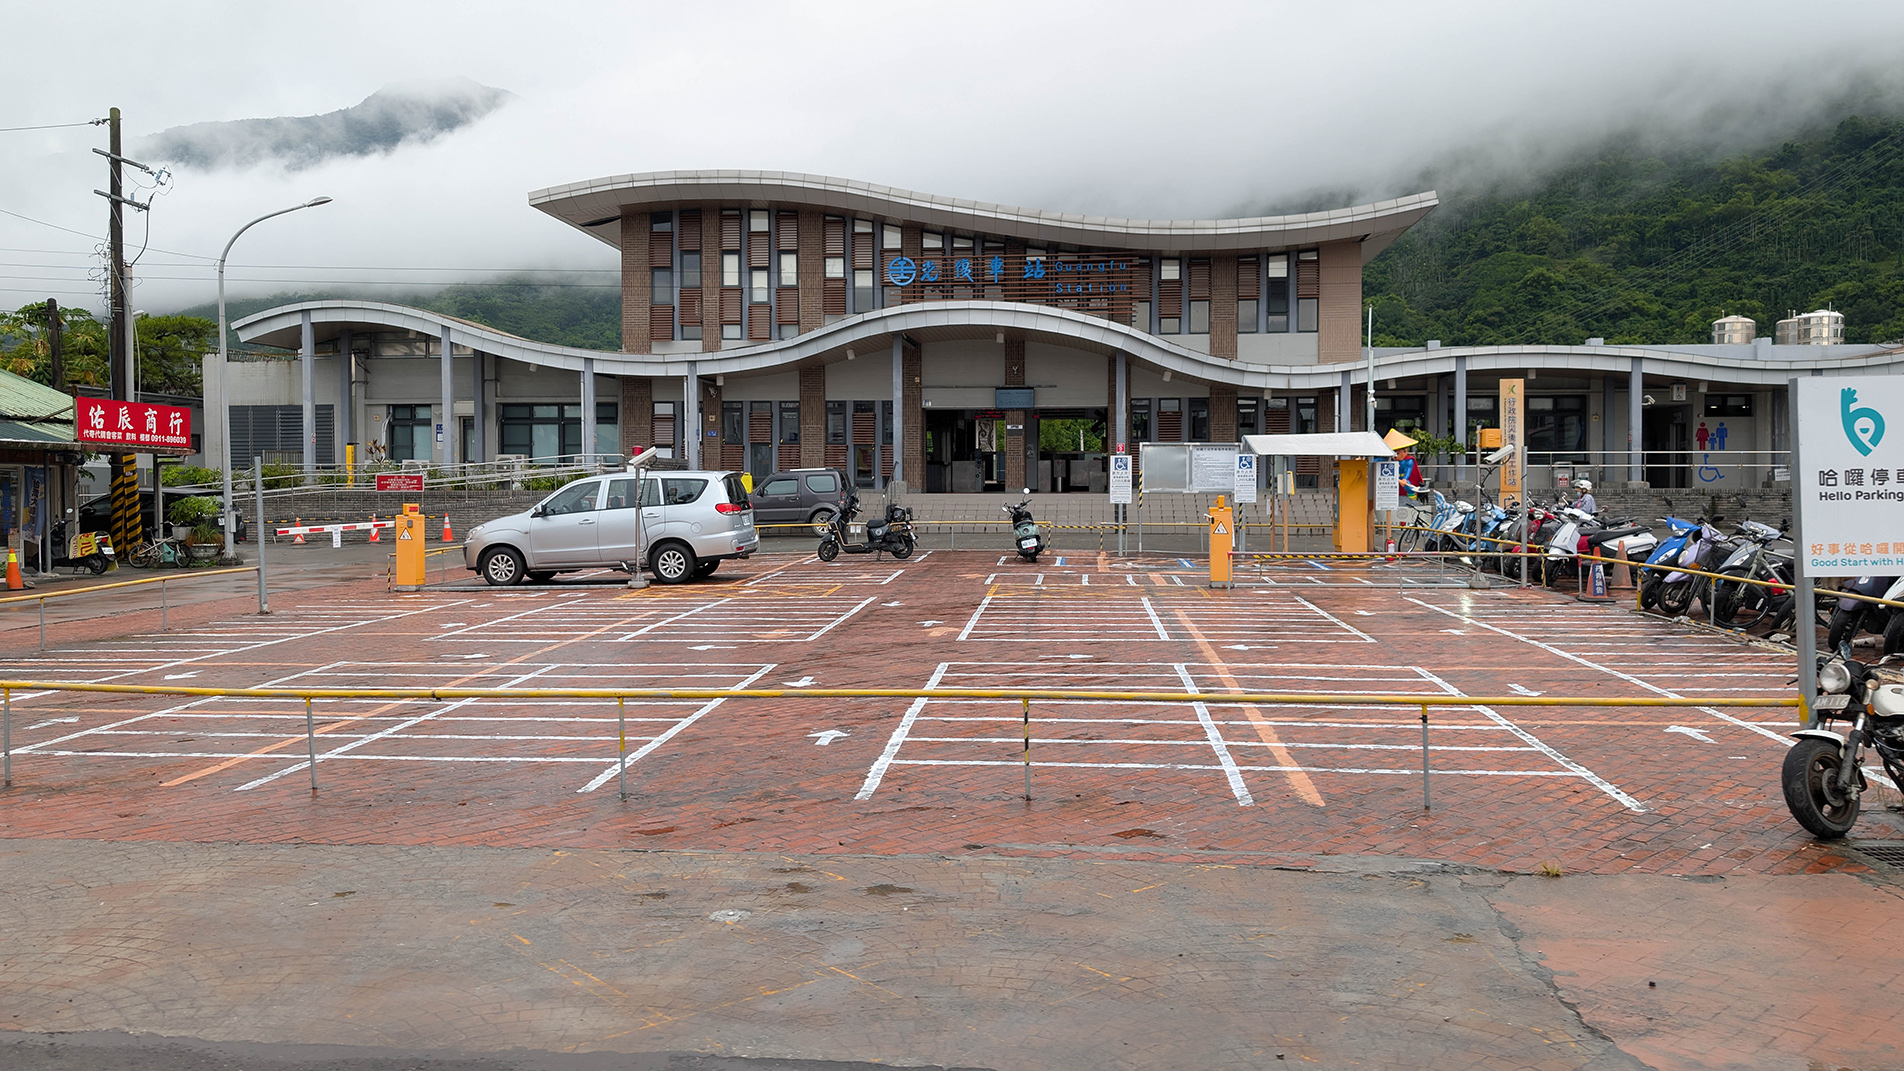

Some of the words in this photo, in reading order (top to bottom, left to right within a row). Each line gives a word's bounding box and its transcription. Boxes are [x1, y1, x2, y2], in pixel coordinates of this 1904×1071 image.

[920, 254, 1046, 284] 光復車站
[1054, 260, 1127, 273] Guangfu
[1055, 282, 1127, 294] Station
[88, 404, 184, 436] 佑辰商行
[1508, 397, 1516, 486] 行政院災後建工作站
[1819, 491, 1852, 501] Hello
[1855, 489, 1904, 502] Parking
[1811, 542, 1904, 555] 好事從哈囉開
[1811, 558, 1838, 567] Good
[1840, 558, 1868, 567] Start
[1870, 557, 1893, 566] with
